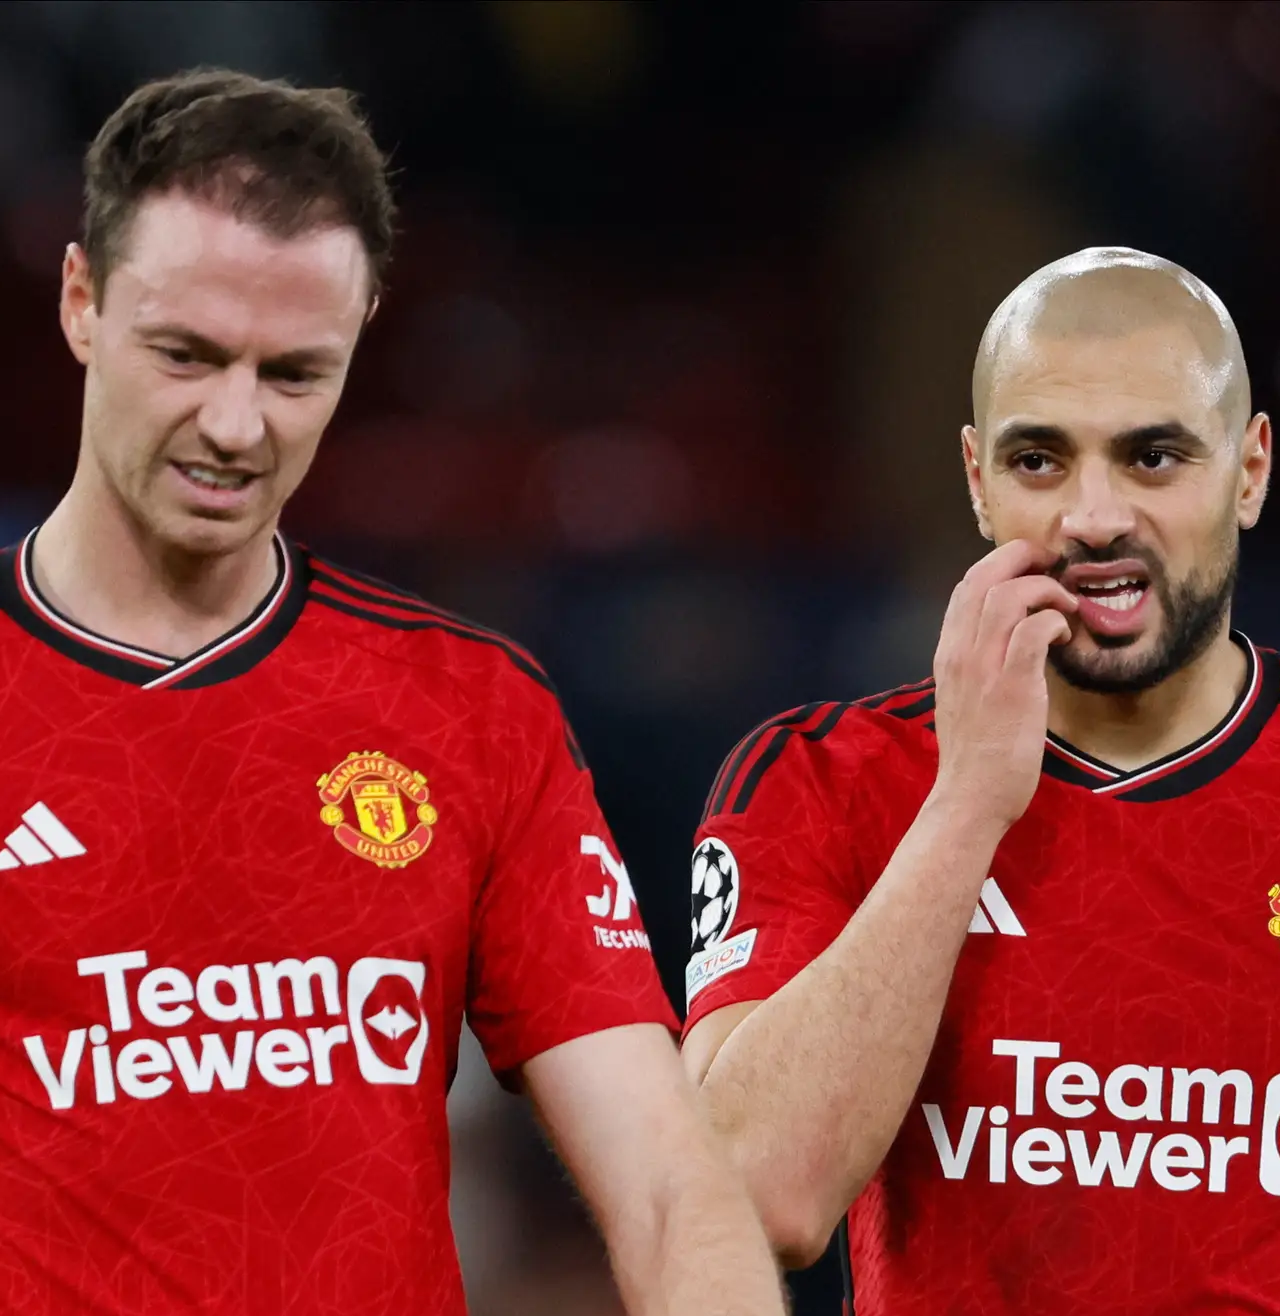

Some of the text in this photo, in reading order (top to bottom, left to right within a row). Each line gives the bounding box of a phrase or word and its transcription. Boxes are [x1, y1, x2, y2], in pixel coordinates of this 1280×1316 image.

[327, 760, 420, 798] MANCHESTER
[356, 839, 420, 860] UNITED
[77, 950, 342, 1033] Team
[23, 1024, 349, 1110] Viewer
[992, 1039, 1253, 1126] Team
[922, 1103, 1250, 1193] Viewer
